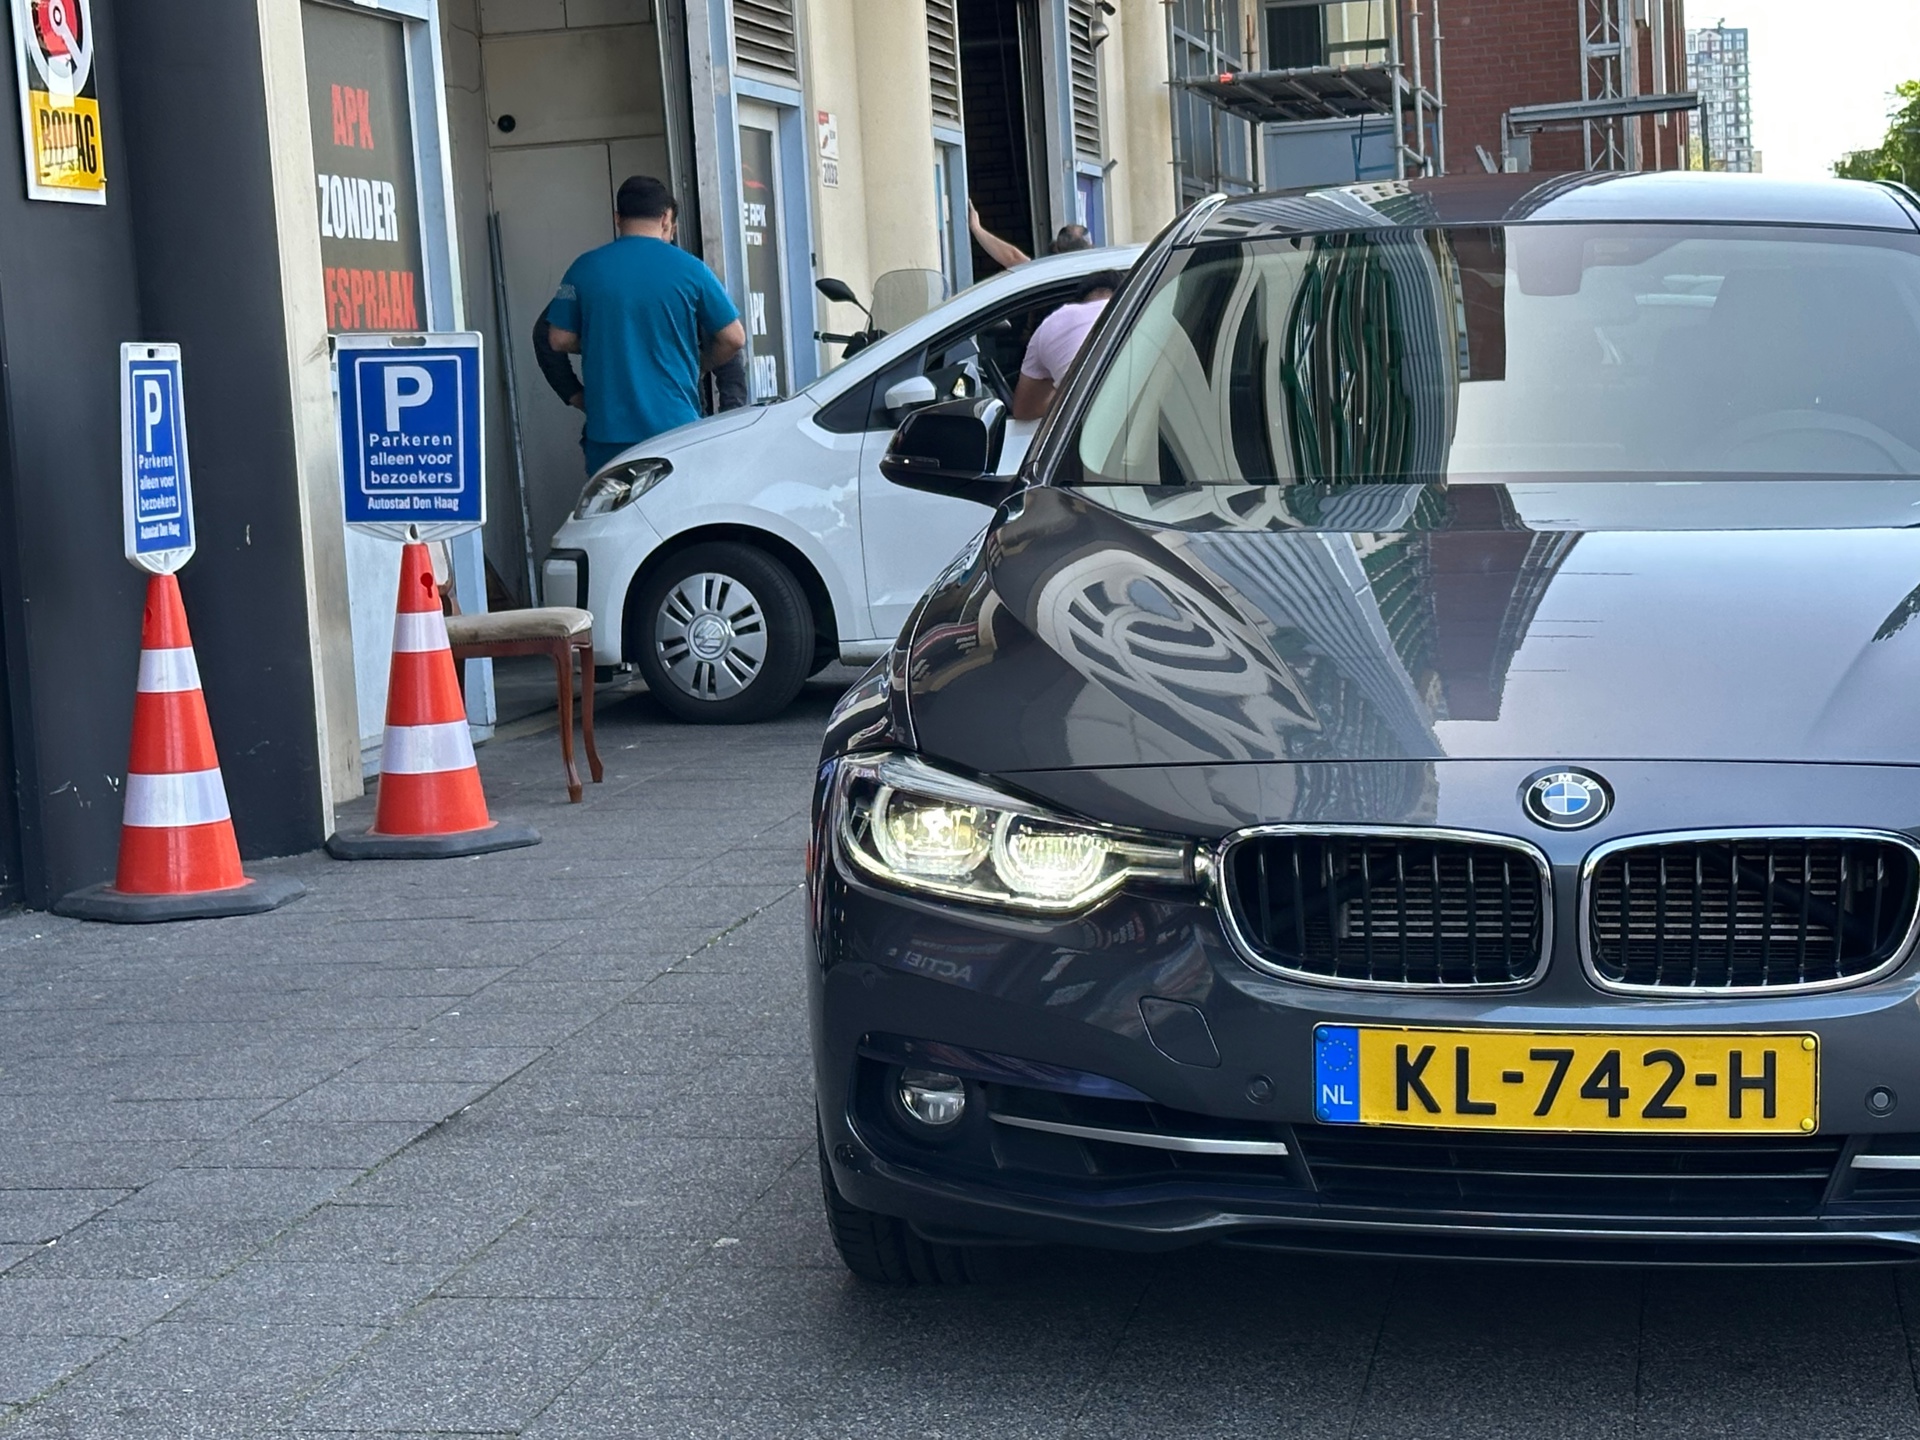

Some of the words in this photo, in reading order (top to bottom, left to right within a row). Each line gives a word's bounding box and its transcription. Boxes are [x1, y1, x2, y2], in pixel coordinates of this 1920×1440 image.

[331, 84, 375, 150] APK
[40, 108, 97, 175] BOVAG
[318, 173, 399, 242] ZONDER
[323, 267, 419, 331] FSPRAAK
[384, 366, 433, 432] P
[144, 379, 162, 452] P
[369, 433, 453, 447] Parkeren
[139, 453, 173, 470] Parkeren
[370, 451, 414, 466] alleen
[418, 453, 453, 465] voor
[140, 474, 159, 491] alleen
[160, 474, 175, 489] voor
[371, 470, 453, 484] bezoekers
[141, 493, 177, 511] bezoekers
[368, 496, 411, 510] Autostad
[434, 496, 459, 511] Haag
[1534, 773, 1599, 790] BMW
[1396, 1044, 1777, 1120] KL-742-H
[1322, 1084, 1353, 1105] NL
